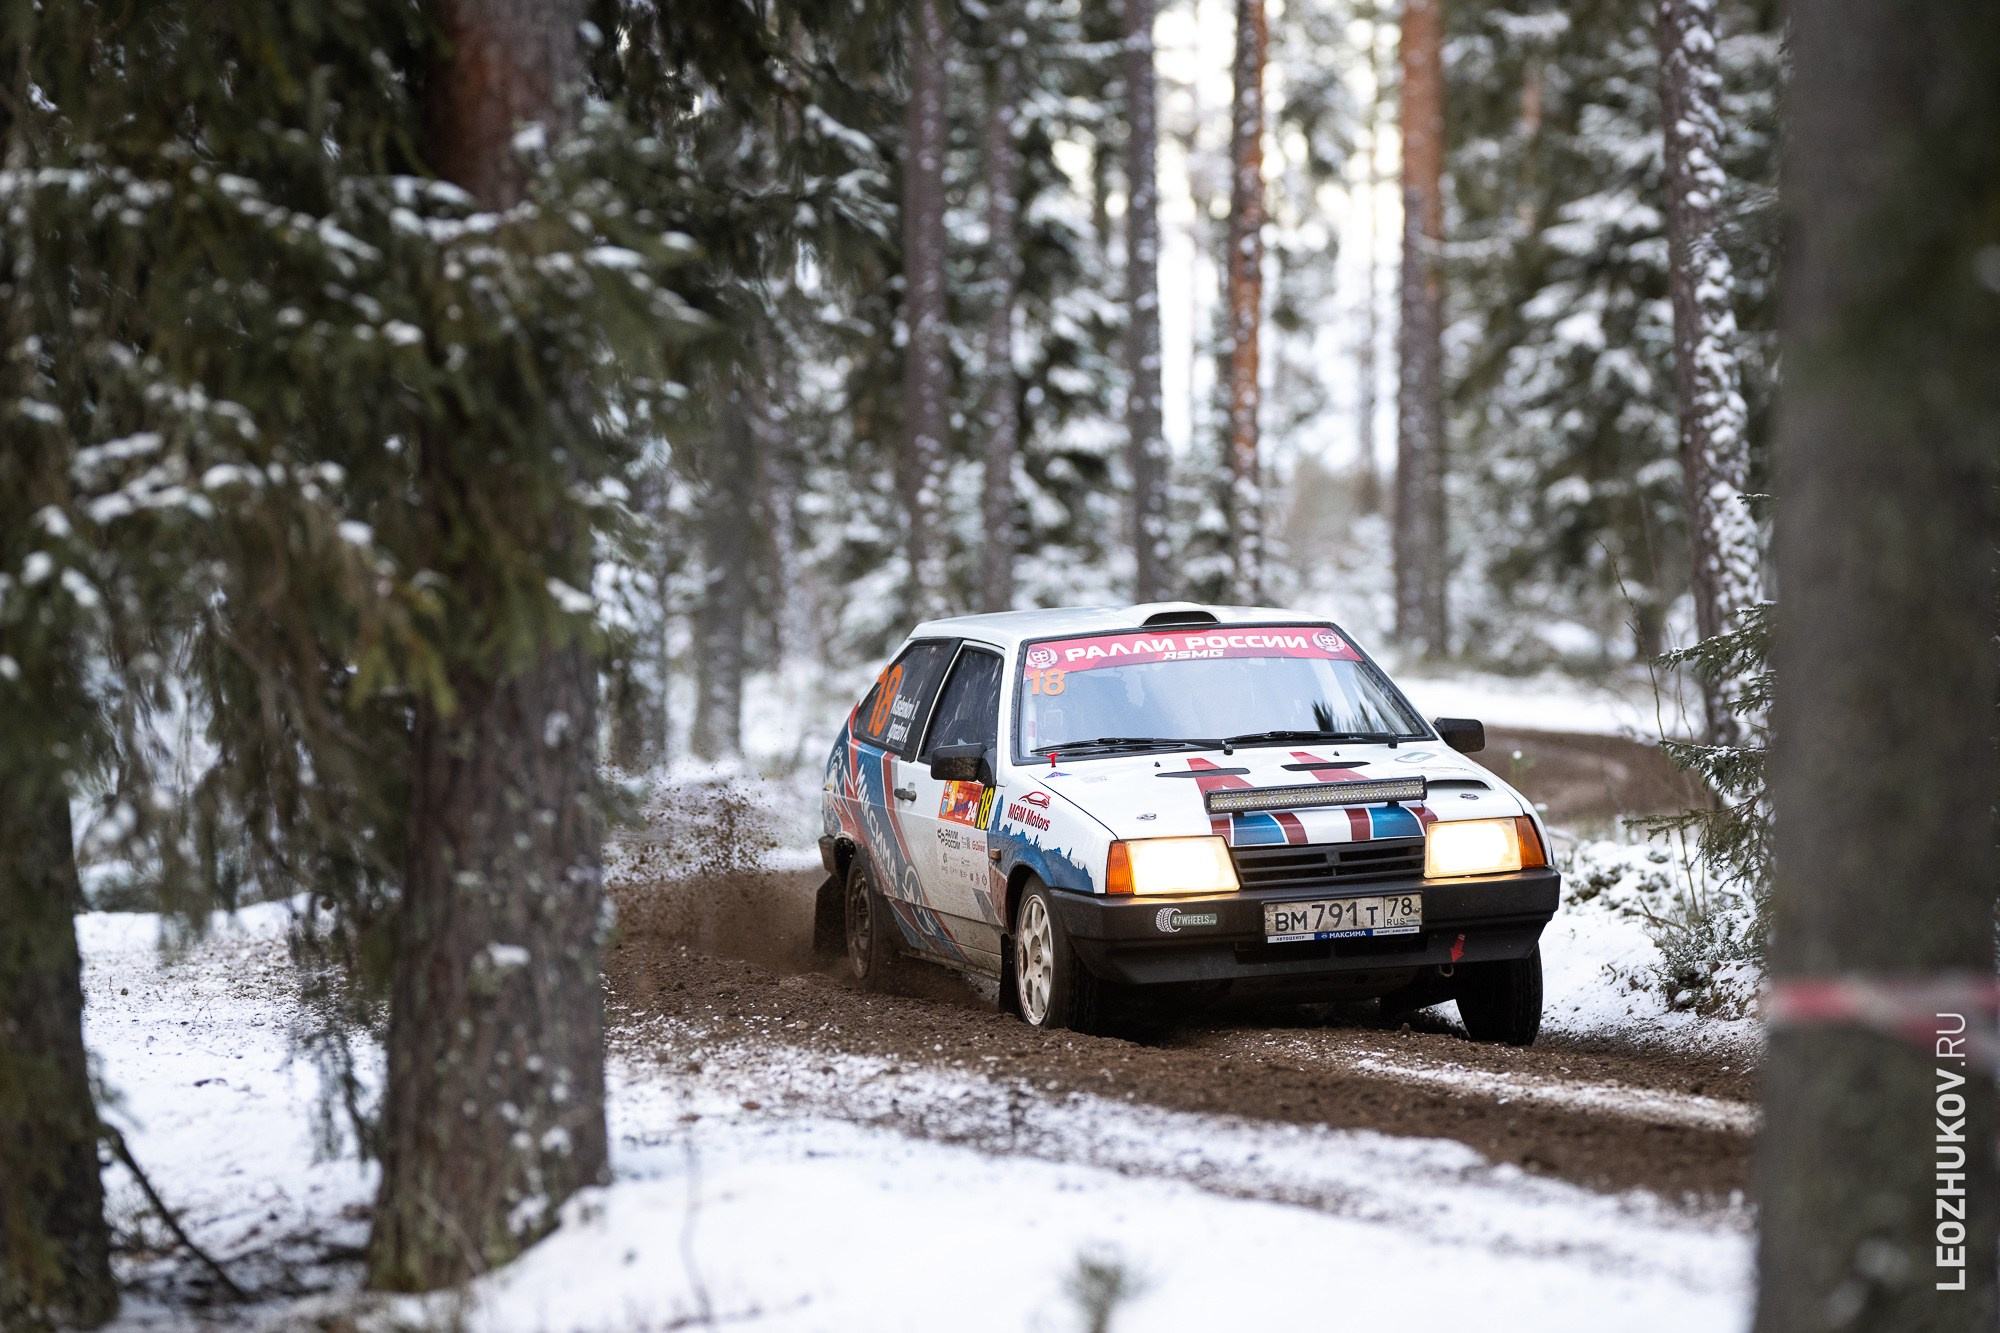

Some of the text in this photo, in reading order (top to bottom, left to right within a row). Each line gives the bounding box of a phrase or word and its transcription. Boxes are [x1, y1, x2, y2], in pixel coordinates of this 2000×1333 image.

[1065, 635, 1309, 662] РАЛЛИ РОССИИ
[1028, 668, 1066, 696] 18
[867, 664, 904, 737] 18
[977, 787, 994, 830] 18
[1007, 803, 1051, 831] MGM Motors
[1387, 897, 1413, 918] 78
[1329, 930, 1367, 939] МАКСИМА
[1386, 918, 1406, 927] RUS
